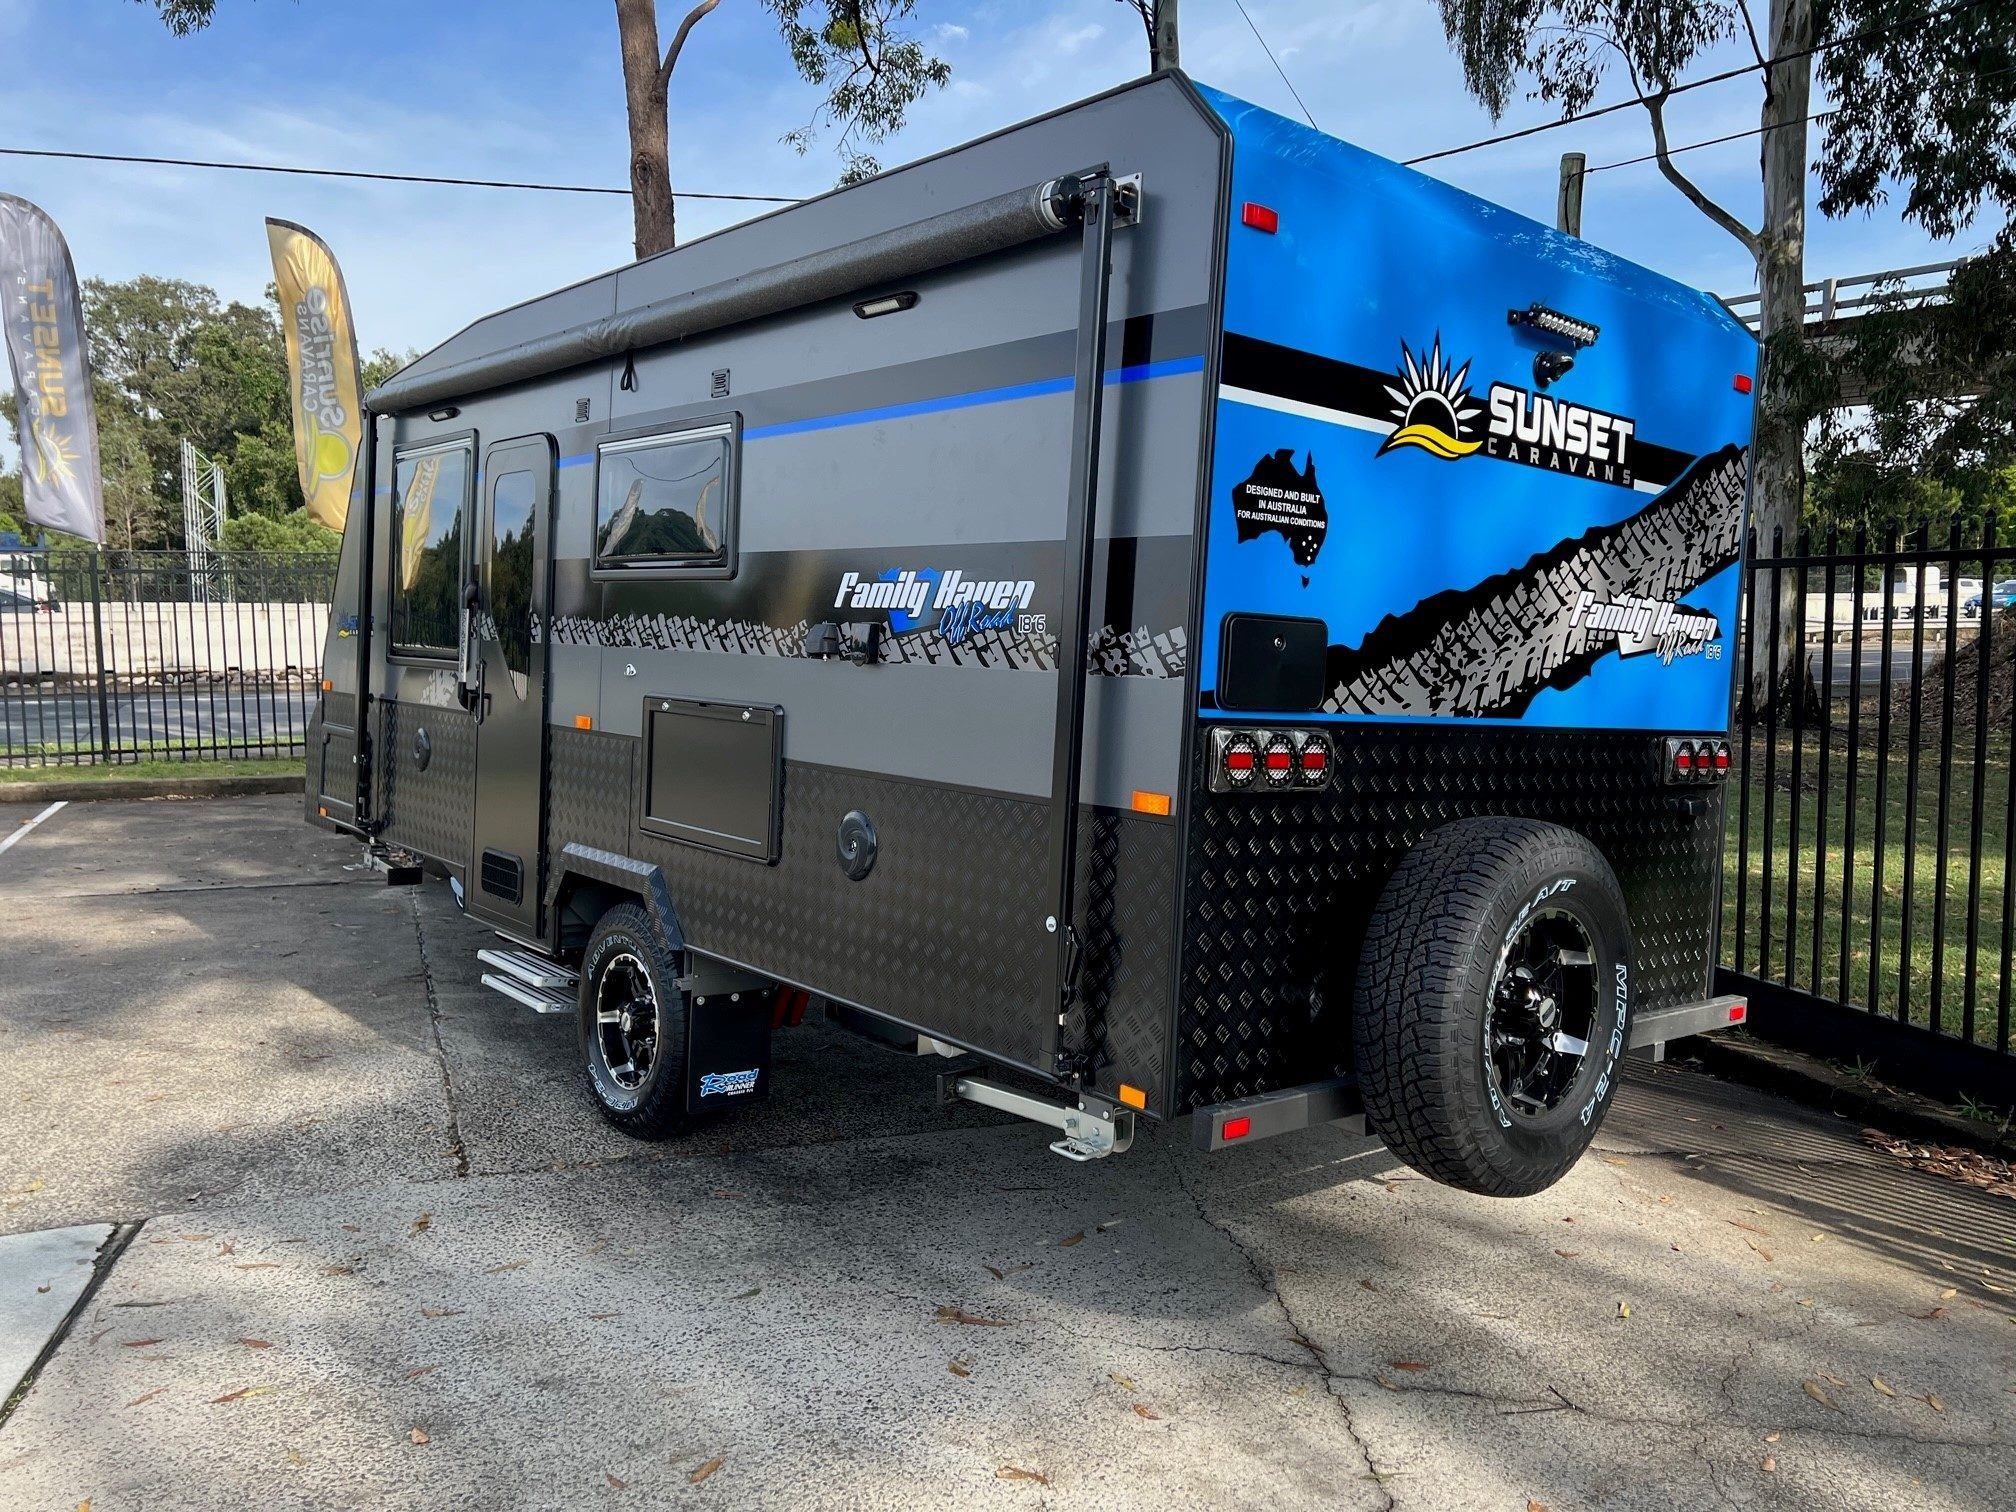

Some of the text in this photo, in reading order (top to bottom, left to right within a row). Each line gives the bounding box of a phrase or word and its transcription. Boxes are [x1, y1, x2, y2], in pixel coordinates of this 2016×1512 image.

[1488, 385, 1634, 465] SUNSET
[1487, 437, 1631, 485] CARAVANS
[1246, 484, 1320, 504] DESIGNED AND BUILT
[1258, 499, 1307, 515] IN AUSTRALIA
[1237, 509, 1326, 529] FOR AUSTRALIAN CONDITIONS
[833, 570, 1036, 618] Family Haven
[1568, 590, 1718, 643] Family Haven
[1532, 879, 1577, 908] A/T
[1580, 963, 1628, 1127] MPC-24
[700, 1068, 759, 1097] Road
